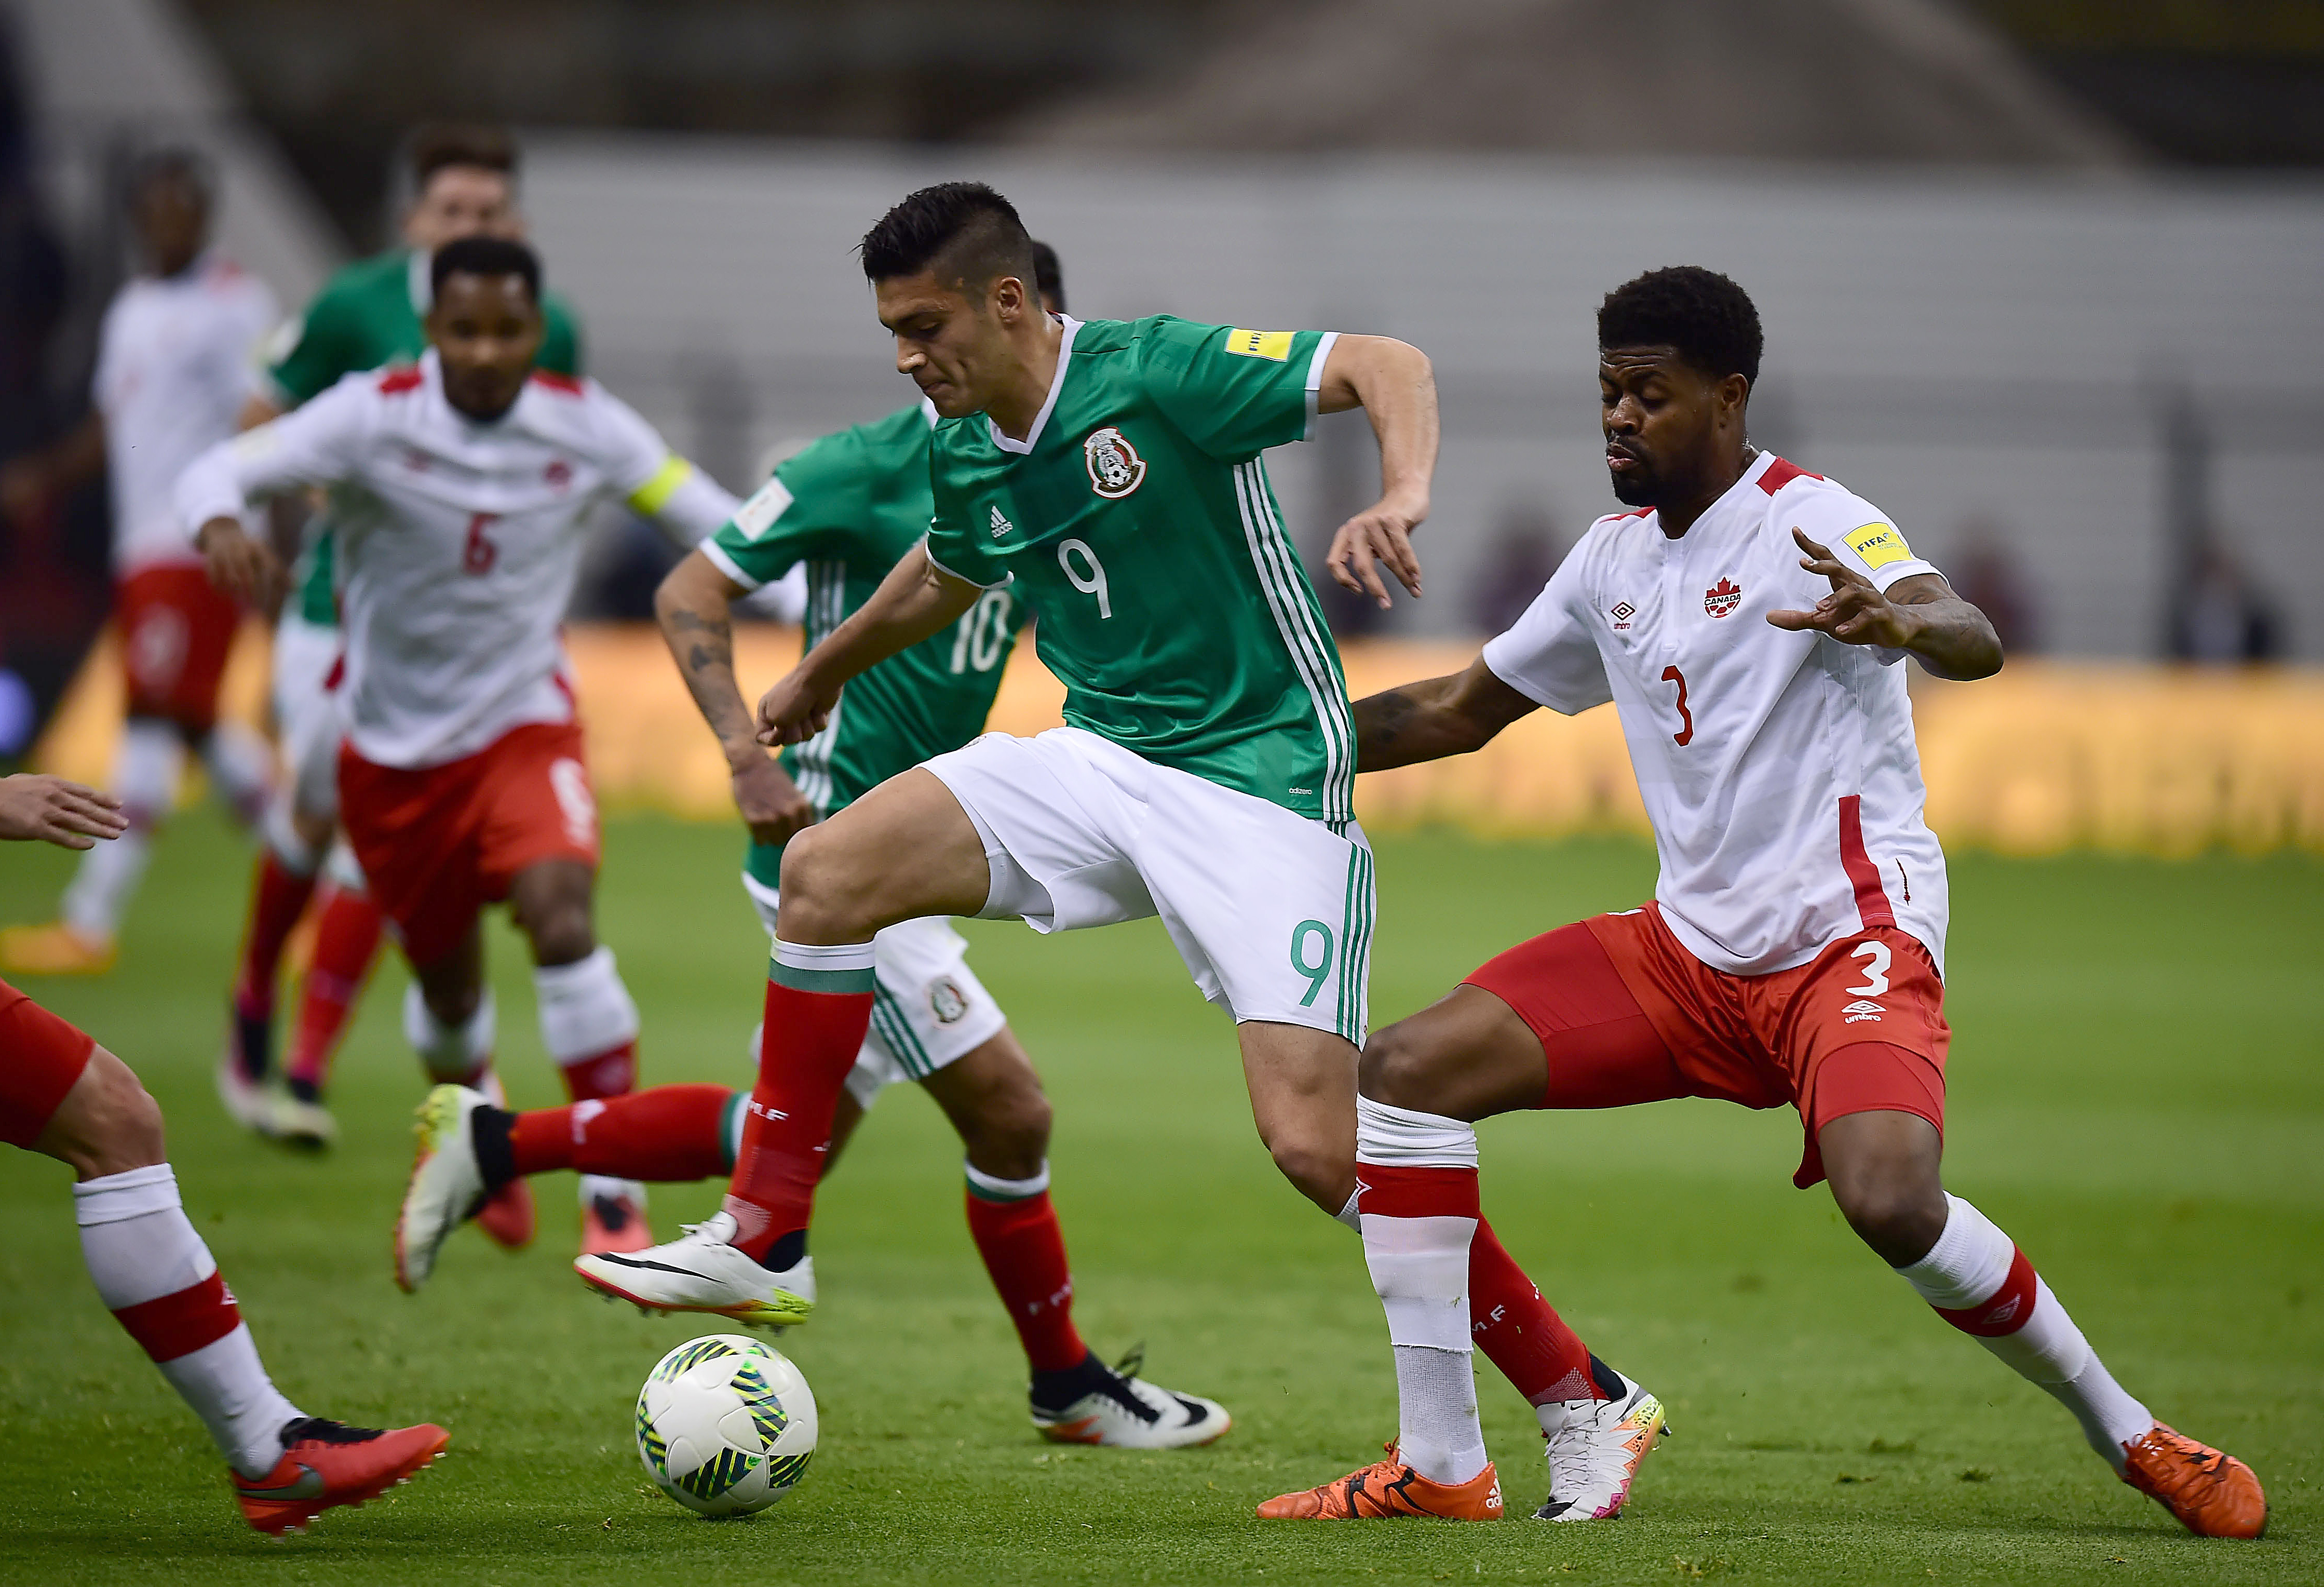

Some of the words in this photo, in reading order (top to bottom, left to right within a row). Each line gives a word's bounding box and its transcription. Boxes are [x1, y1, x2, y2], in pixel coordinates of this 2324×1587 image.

[464, 511, 502, 577] 6
[1857, 536, 1887, 553] FIFA
[1057, 538, 1112, 620] 9
[1704, 593, 1741, 606] CANADA
[951, 589, 1013, 675] 10
[1661, 665, 1694, 747] 3
[1290, 919, 1334, 1007] 9
[1845, 940, 1891, 997] 3
[1845, 1014, 1882, 1024] umbro
